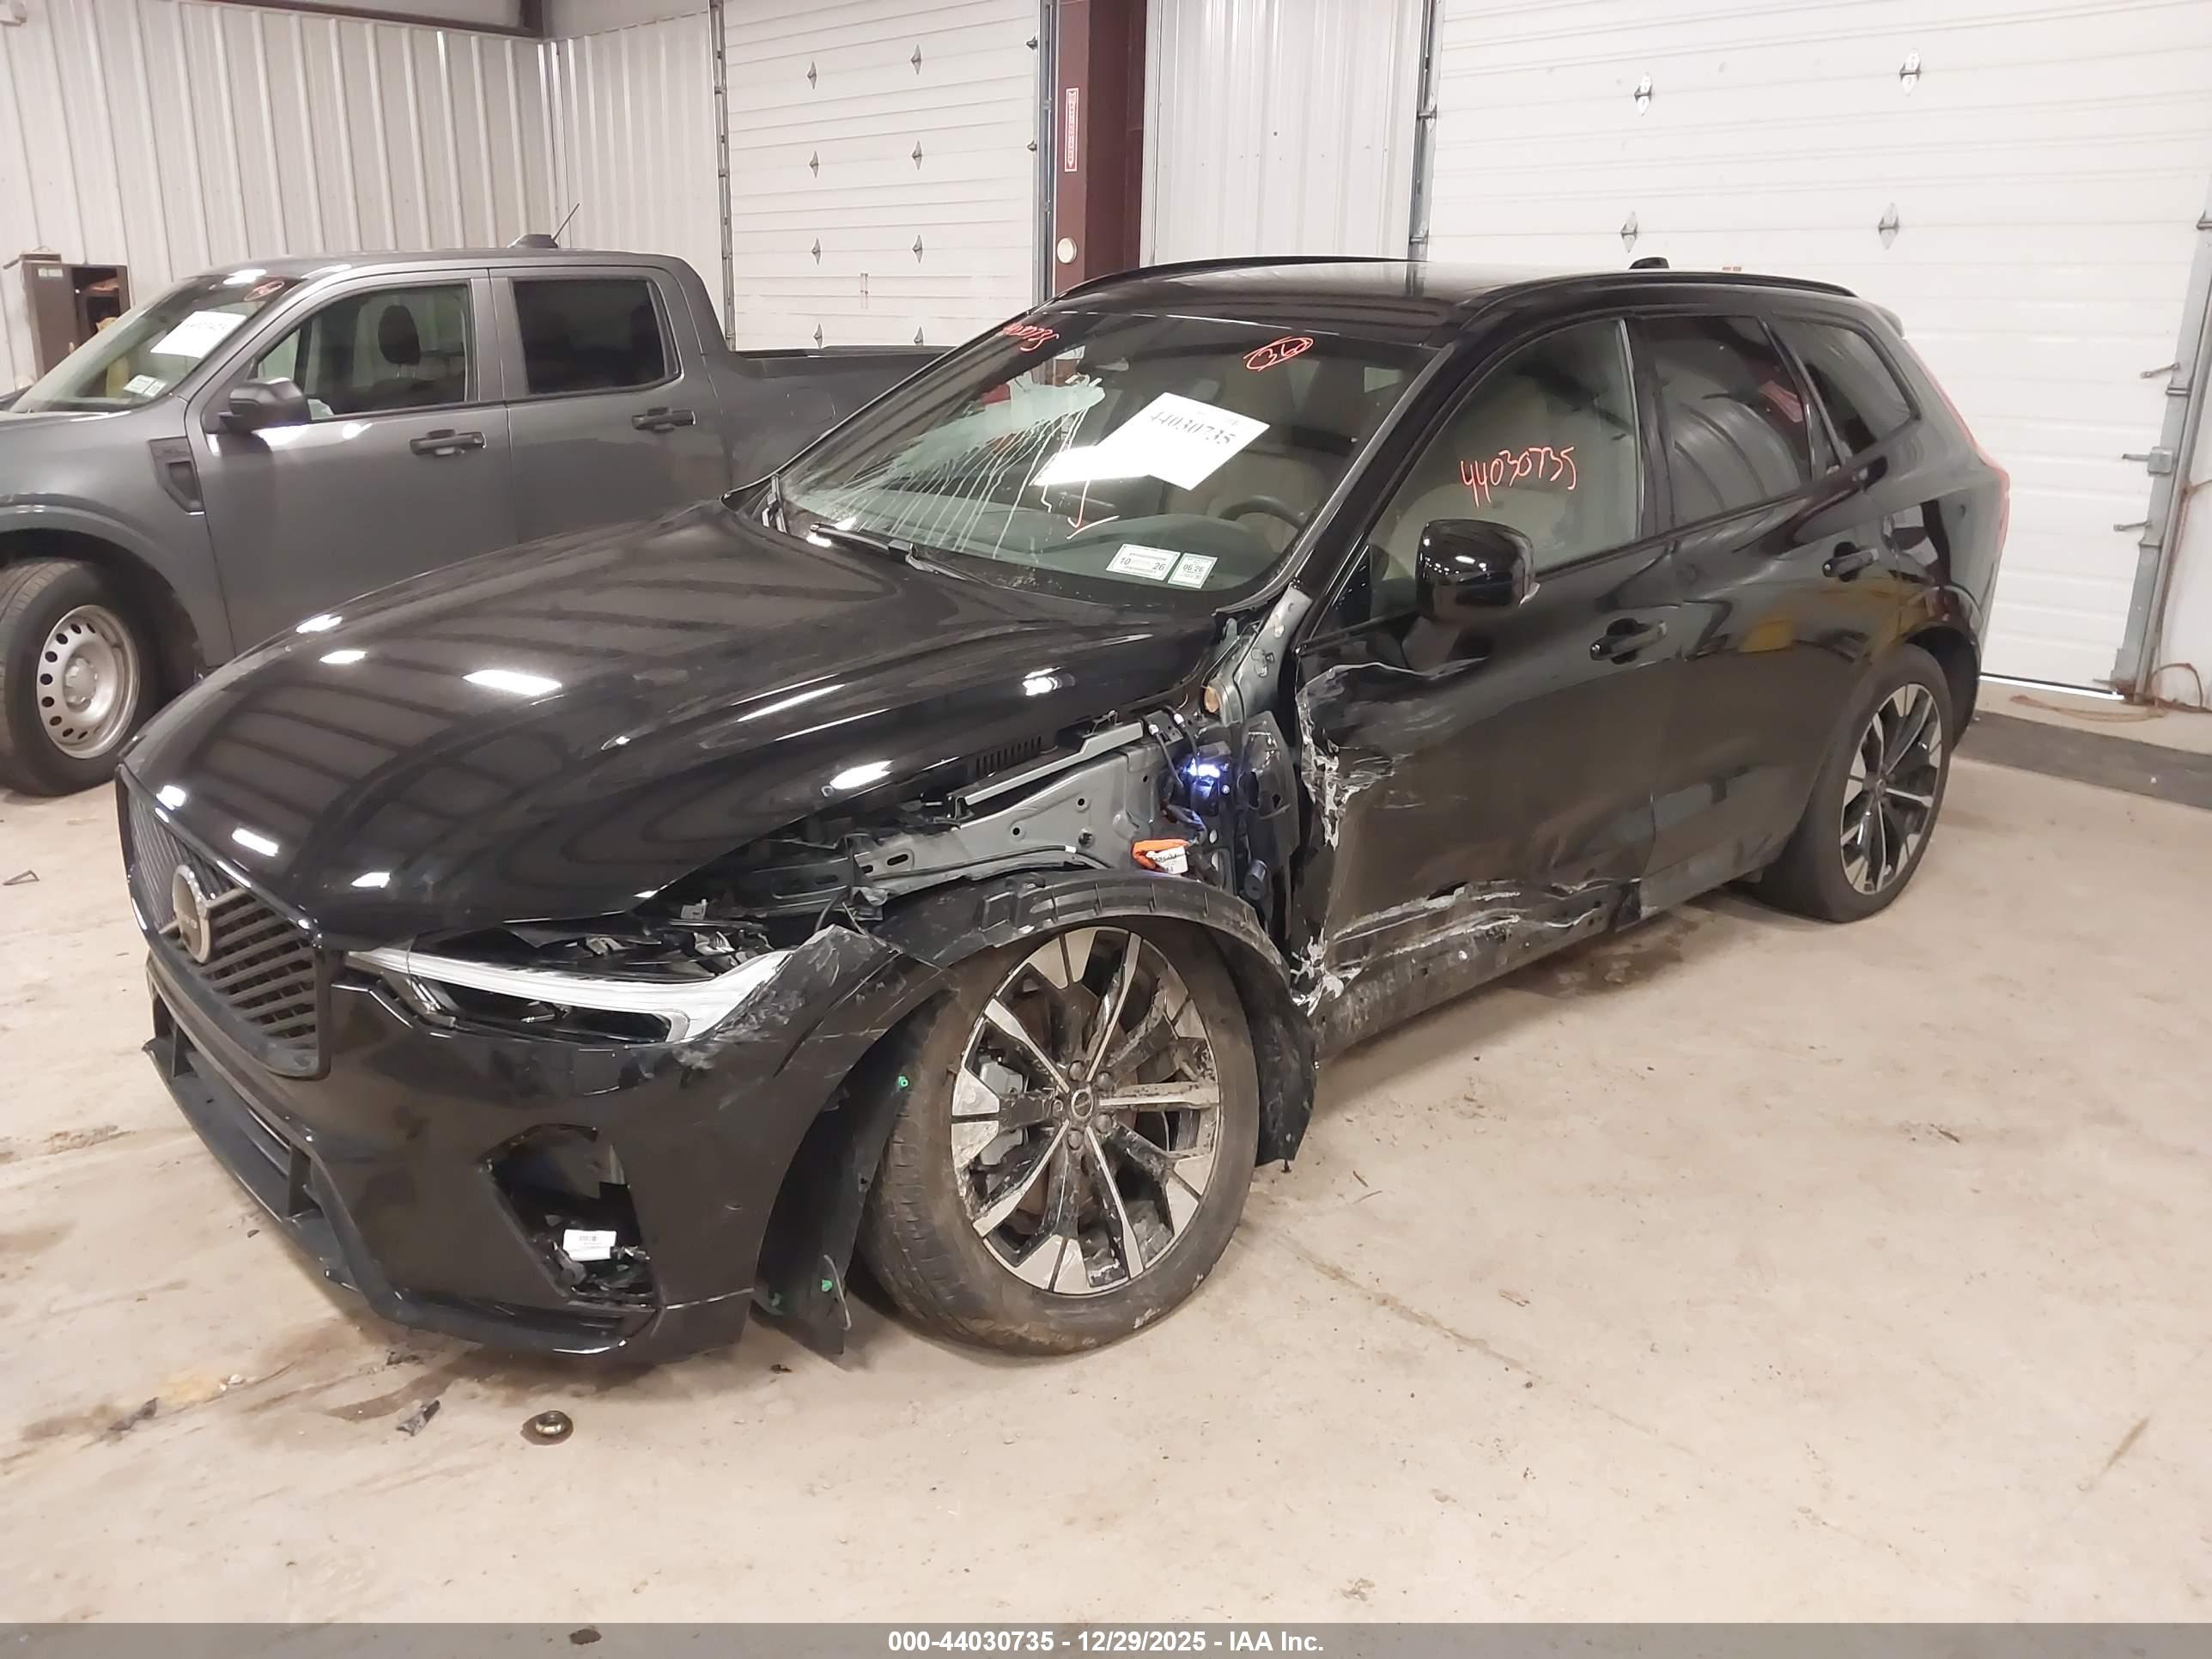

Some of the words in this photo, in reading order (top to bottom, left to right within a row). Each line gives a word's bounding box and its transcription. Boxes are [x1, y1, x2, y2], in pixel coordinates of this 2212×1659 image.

[1150, 411, 1237, 445] 44030735
[1460, 447, 1577, 508] 44030735
[1120, 556, 1132, 565] 10
[1152, 562, 1166, 571] 26
